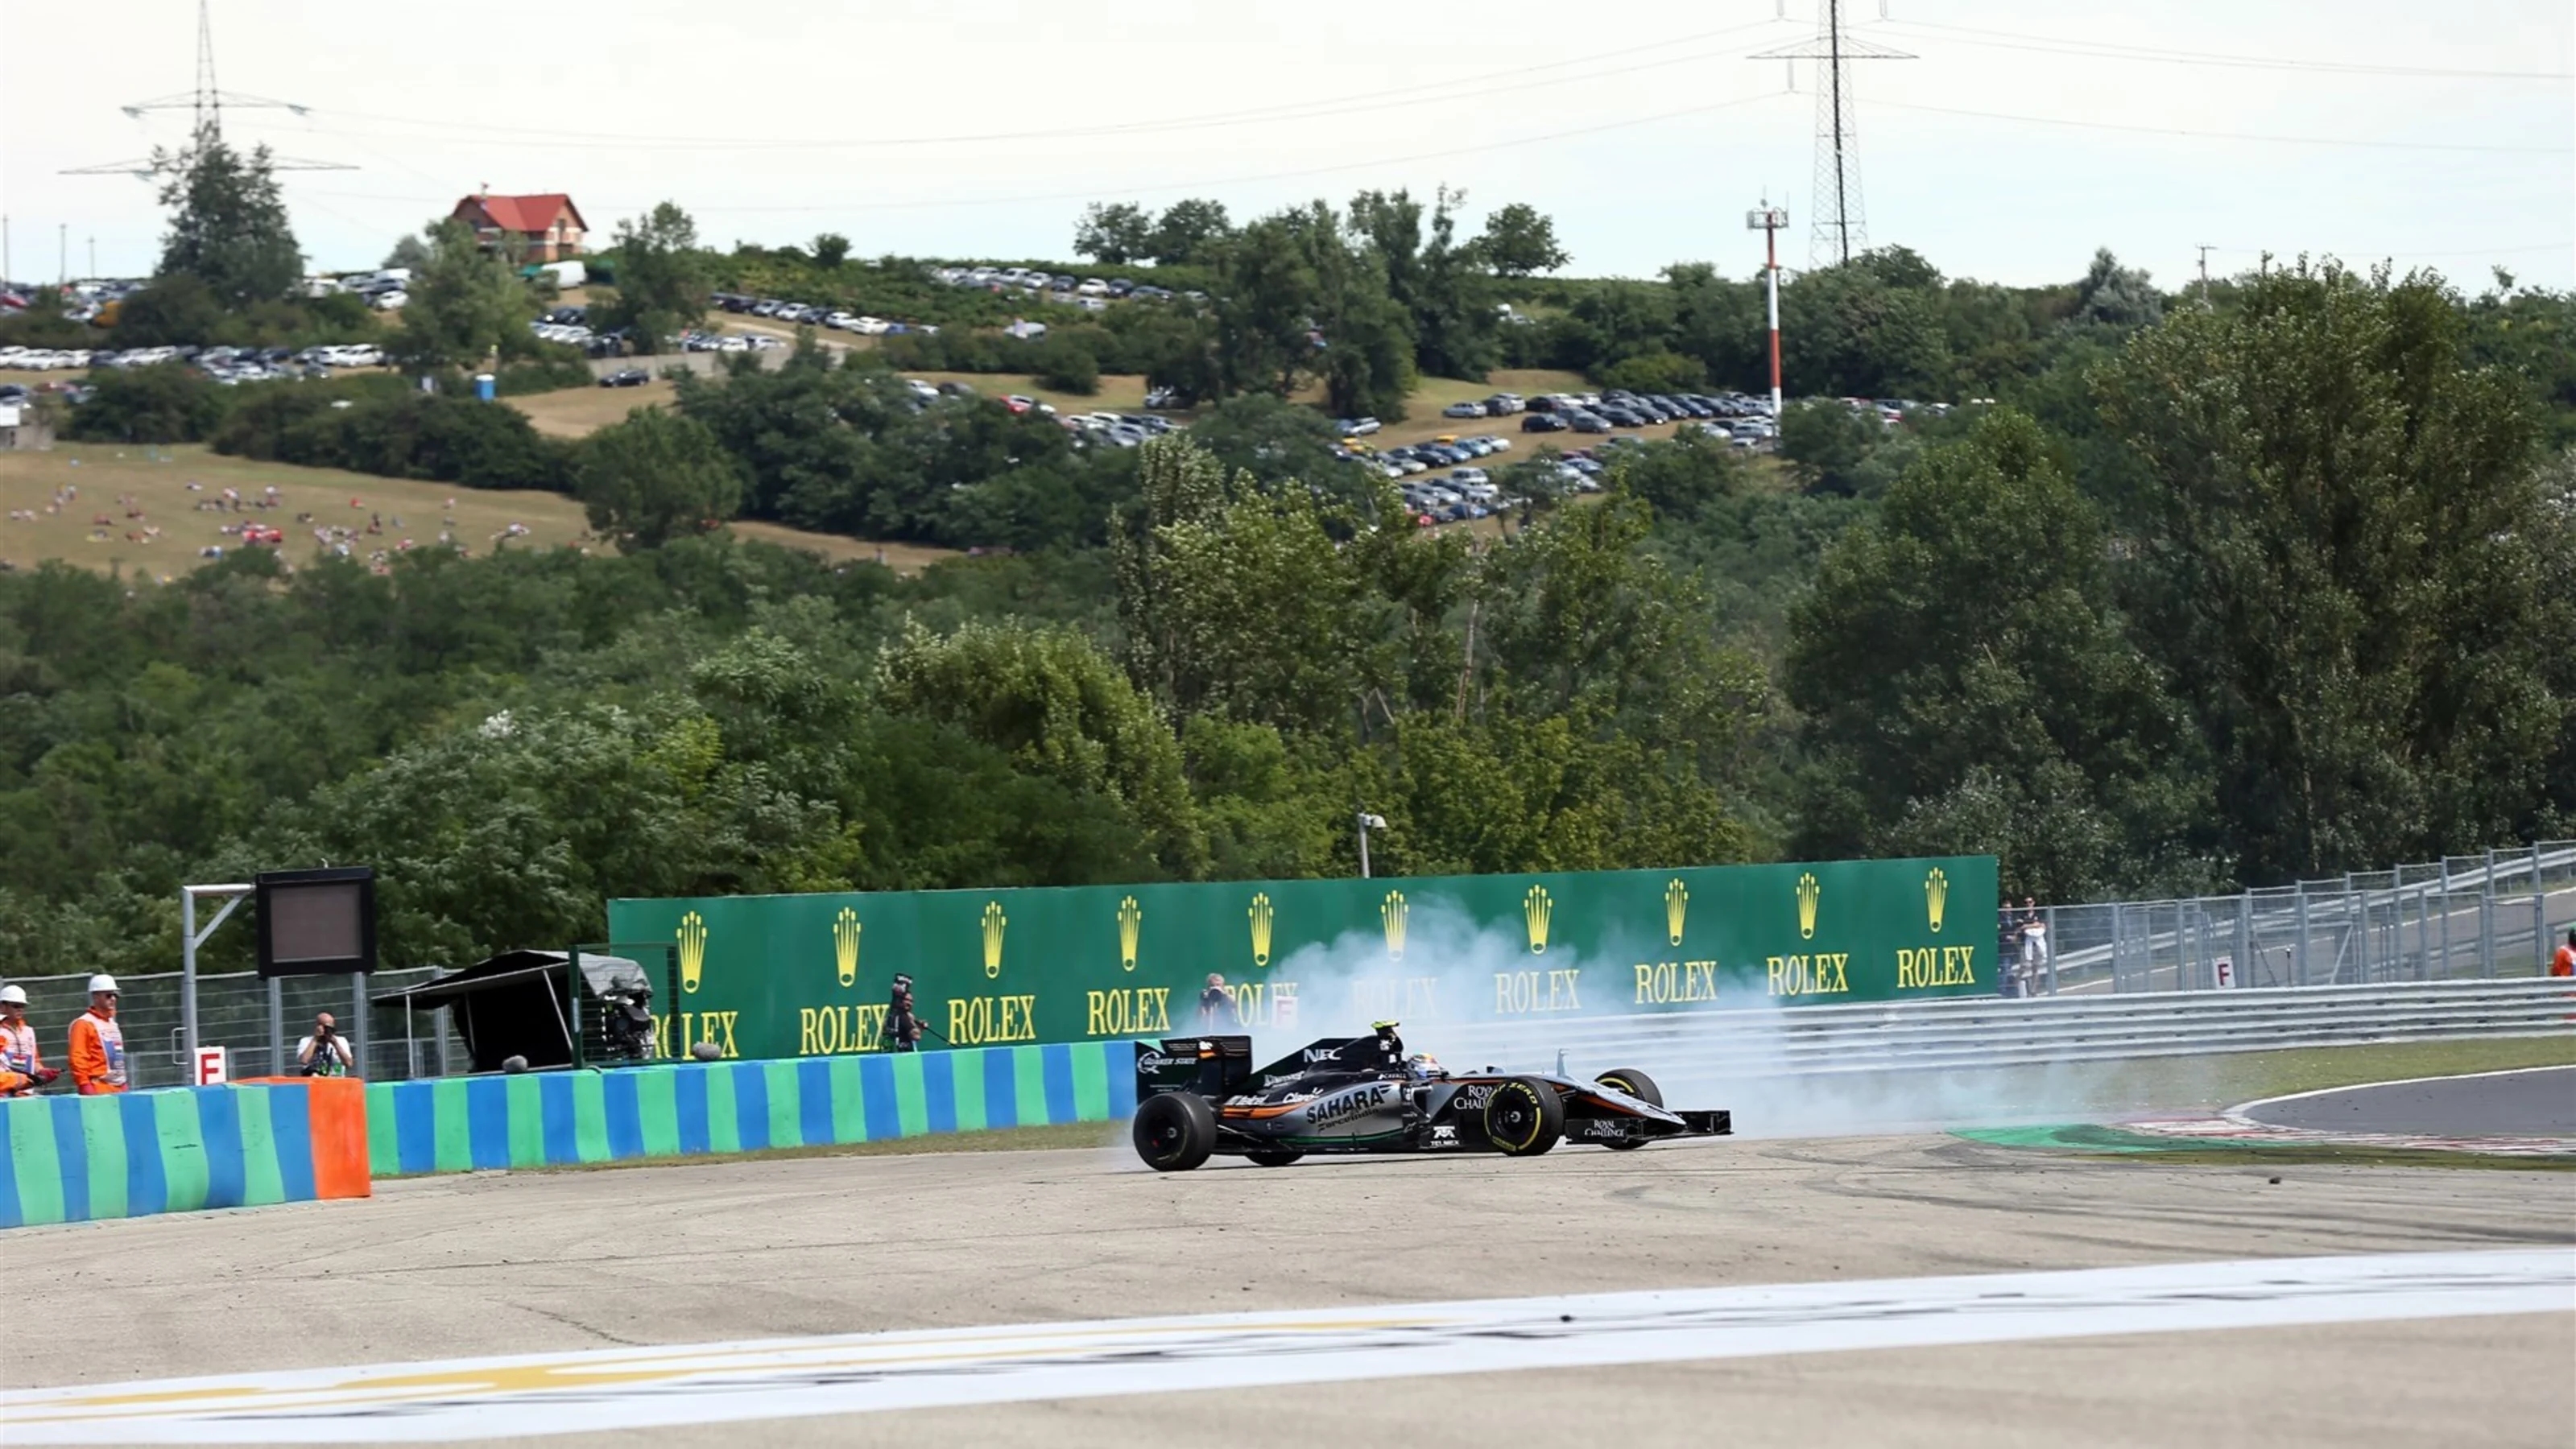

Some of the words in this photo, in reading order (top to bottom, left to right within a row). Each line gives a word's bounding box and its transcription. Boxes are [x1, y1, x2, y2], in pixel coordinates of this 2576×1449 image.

[1635, 961, 1718, 1005] ROLEX
[1767, 953, 1849, 996] ROLEX
[1896, 946, 1975, 989] ROLEX
[2218, 964, 2230, 986] F
[1087, 988, 1171, 1035] ROLEX
[1277, 999, 1292, 1022] F
[1495, 969, 1582, 1014] ROLEX
[800, 1004, 890, 1055] ROLEX
[949, 995, 1036, 1045] ROLEX
[201, 1053, 220, 1085] F
[1304, 1047, 1343, 1063] NEC
[1306, 1087, 1385, 1125] SAHARA
[1468, 1085, 1492, 1097] ROY
[1508, 1082, 1538, 1104] ZERO
